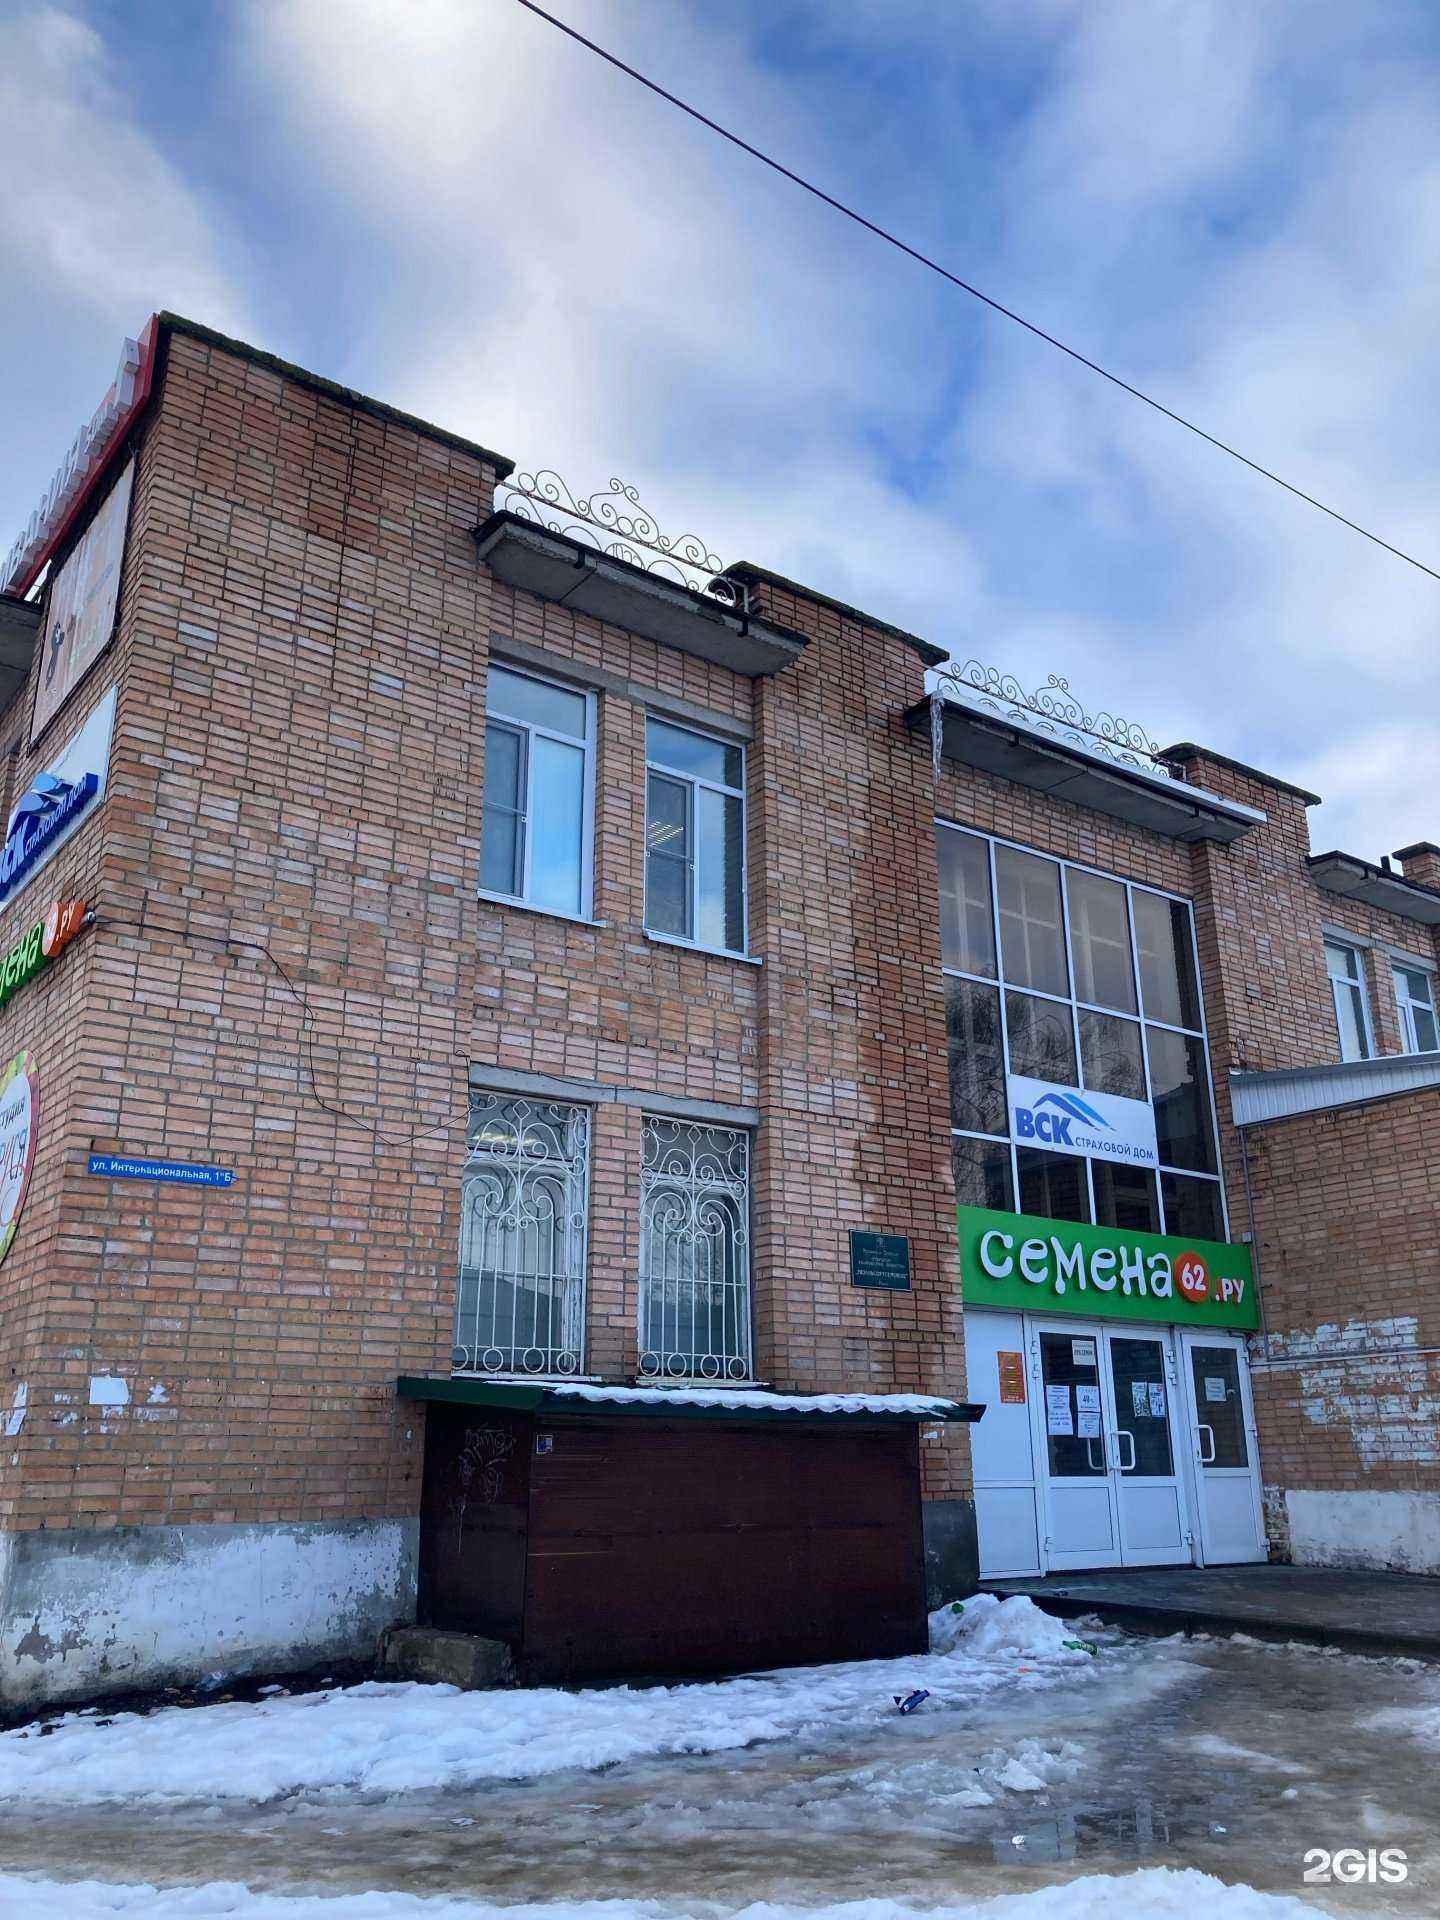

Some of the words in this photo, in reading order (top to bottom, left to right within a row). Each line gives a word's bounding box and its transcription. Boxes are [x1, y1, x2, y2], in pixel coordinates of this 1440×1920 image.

[1015, 1107, 1075, 1147] ВСК
[1075, 1137, 1131, 1155] СТРАХОВОЙ
[1133, 1147, 1154, 1160] ДОМ
[92, 1161, 108, 1171] ул.
[1181, 1262, 1207, 1291] 62
